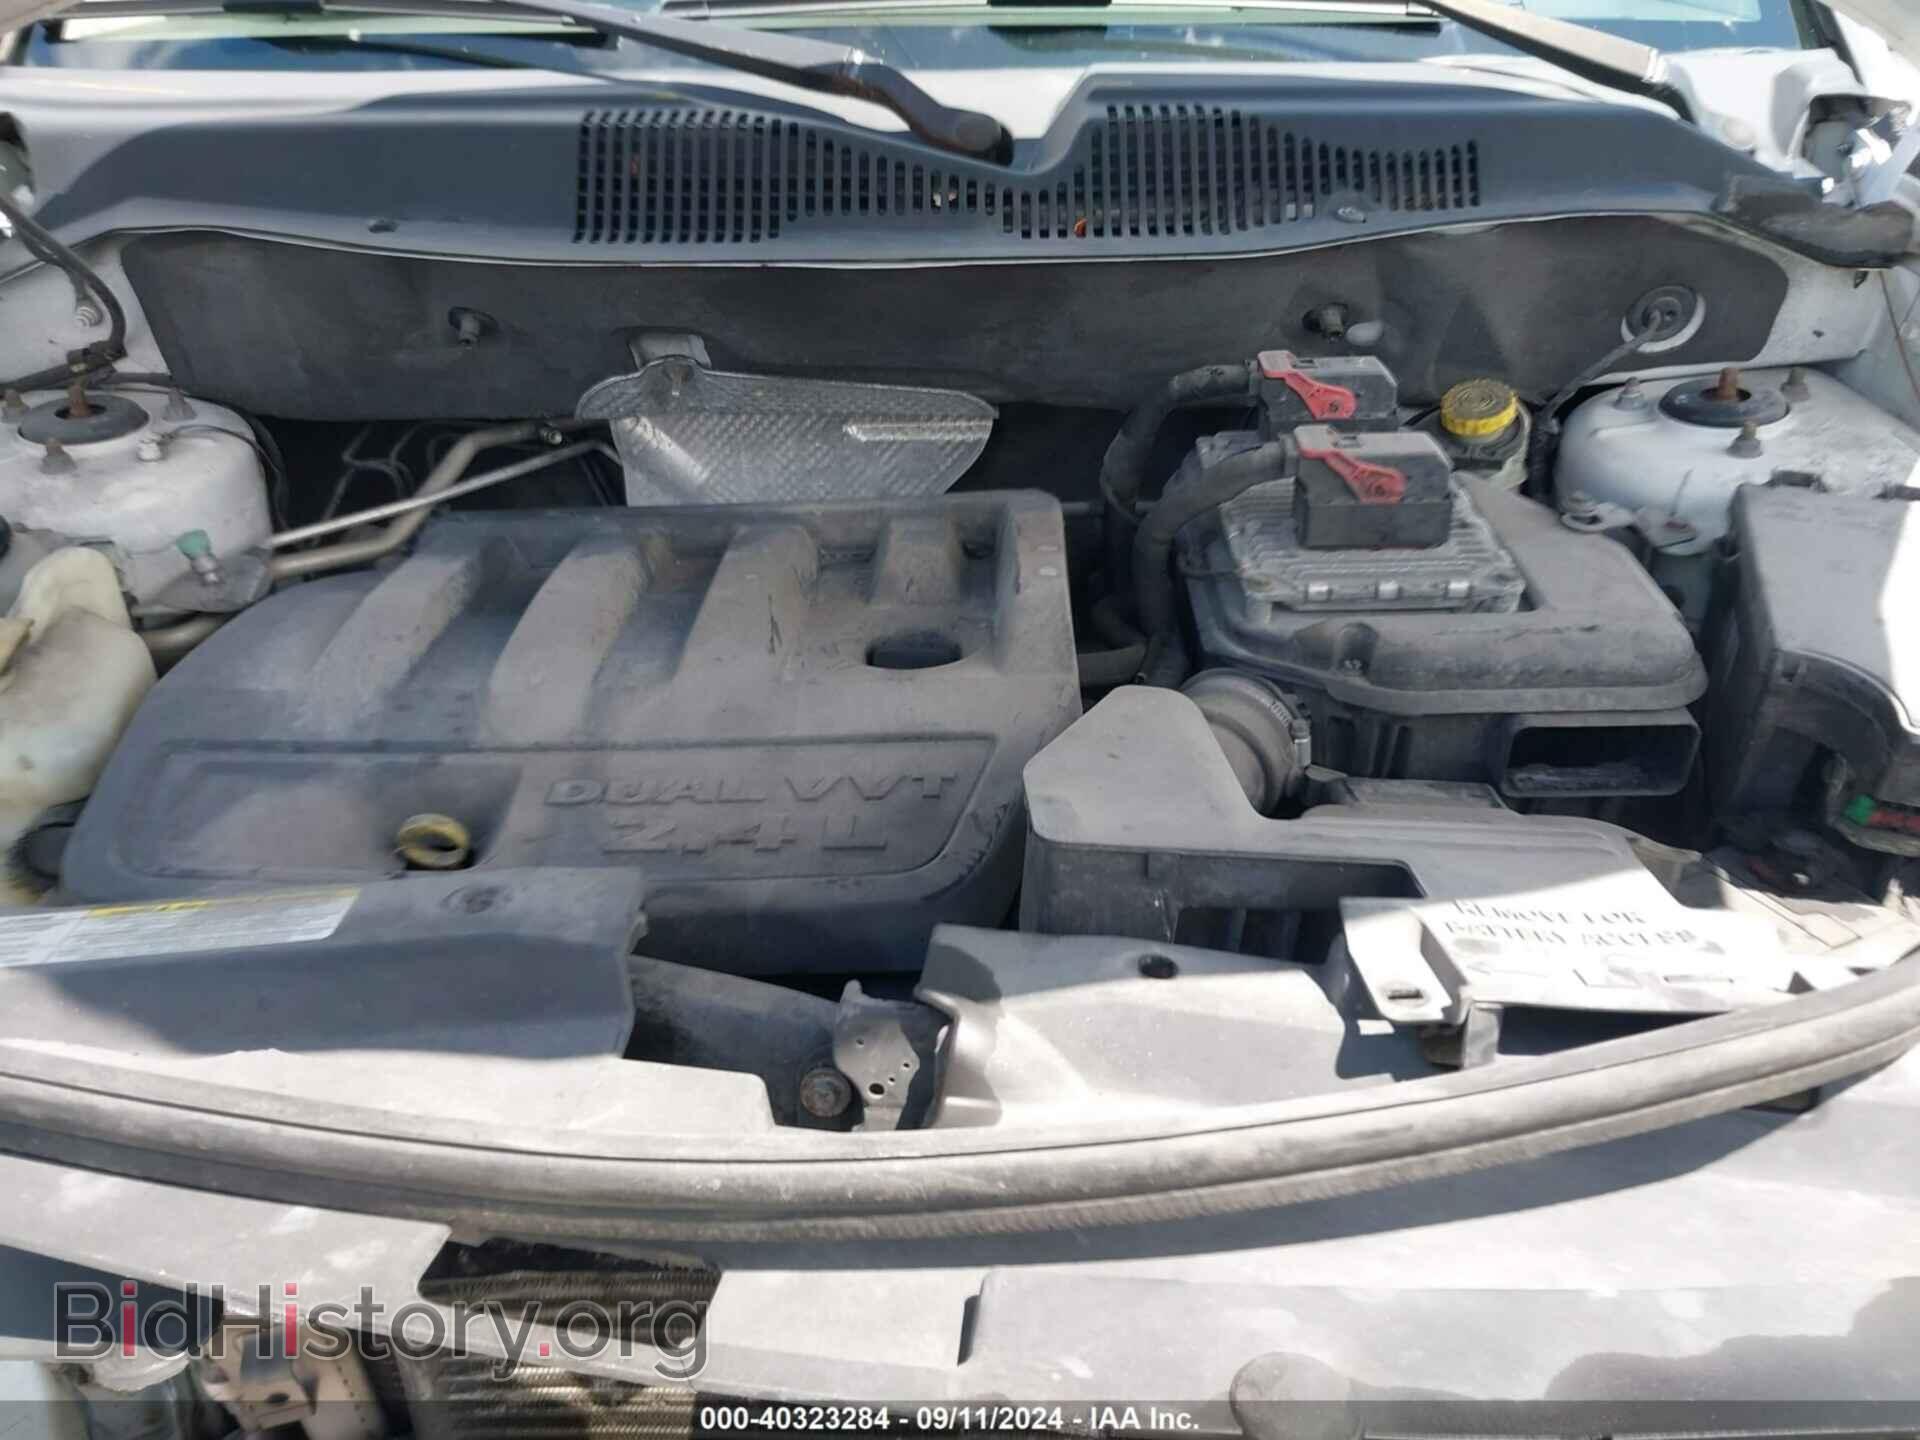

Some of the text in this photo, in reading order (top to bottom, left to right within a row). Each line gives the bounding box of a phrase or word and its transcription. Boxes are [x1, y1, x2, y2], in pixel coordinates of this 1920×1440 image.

[544, 774, 957, 806] DUAL VVT
[1582, 910, 1647, 925] FOR
